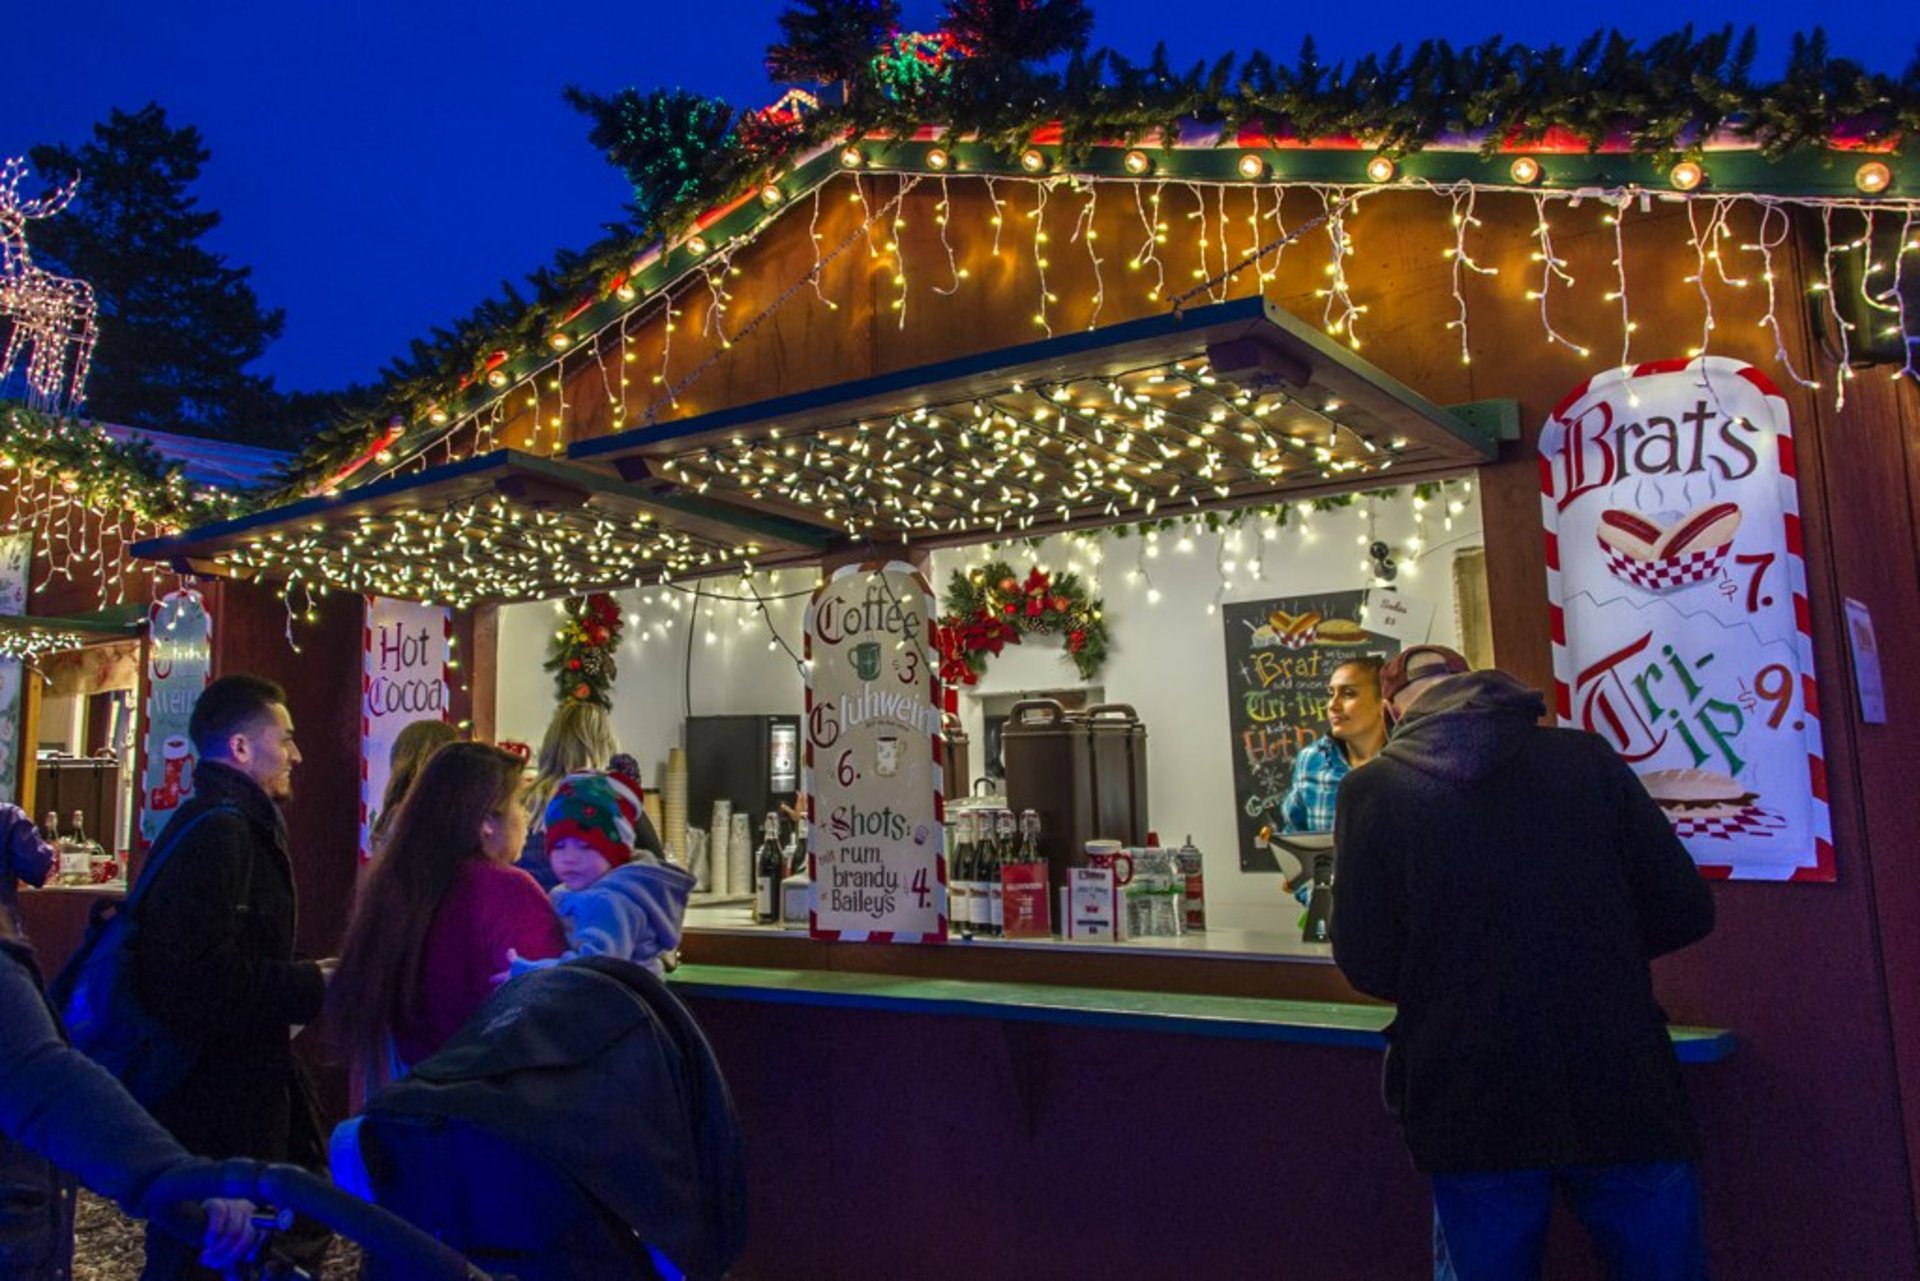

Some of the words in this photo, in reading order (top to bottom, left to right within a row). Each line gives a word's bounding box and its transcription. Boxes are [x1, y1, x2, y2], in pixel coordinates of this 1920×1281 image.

[1554, 399, 1760, 514] Brats
[816, 584, 921, 645] Coffee
[378, 622, 430, 672] Hot
[1251, 651, 1322, 687] Brat
[368, 676, 442, 717] Cocoa
[831, 804, 912, 842] Shots:
